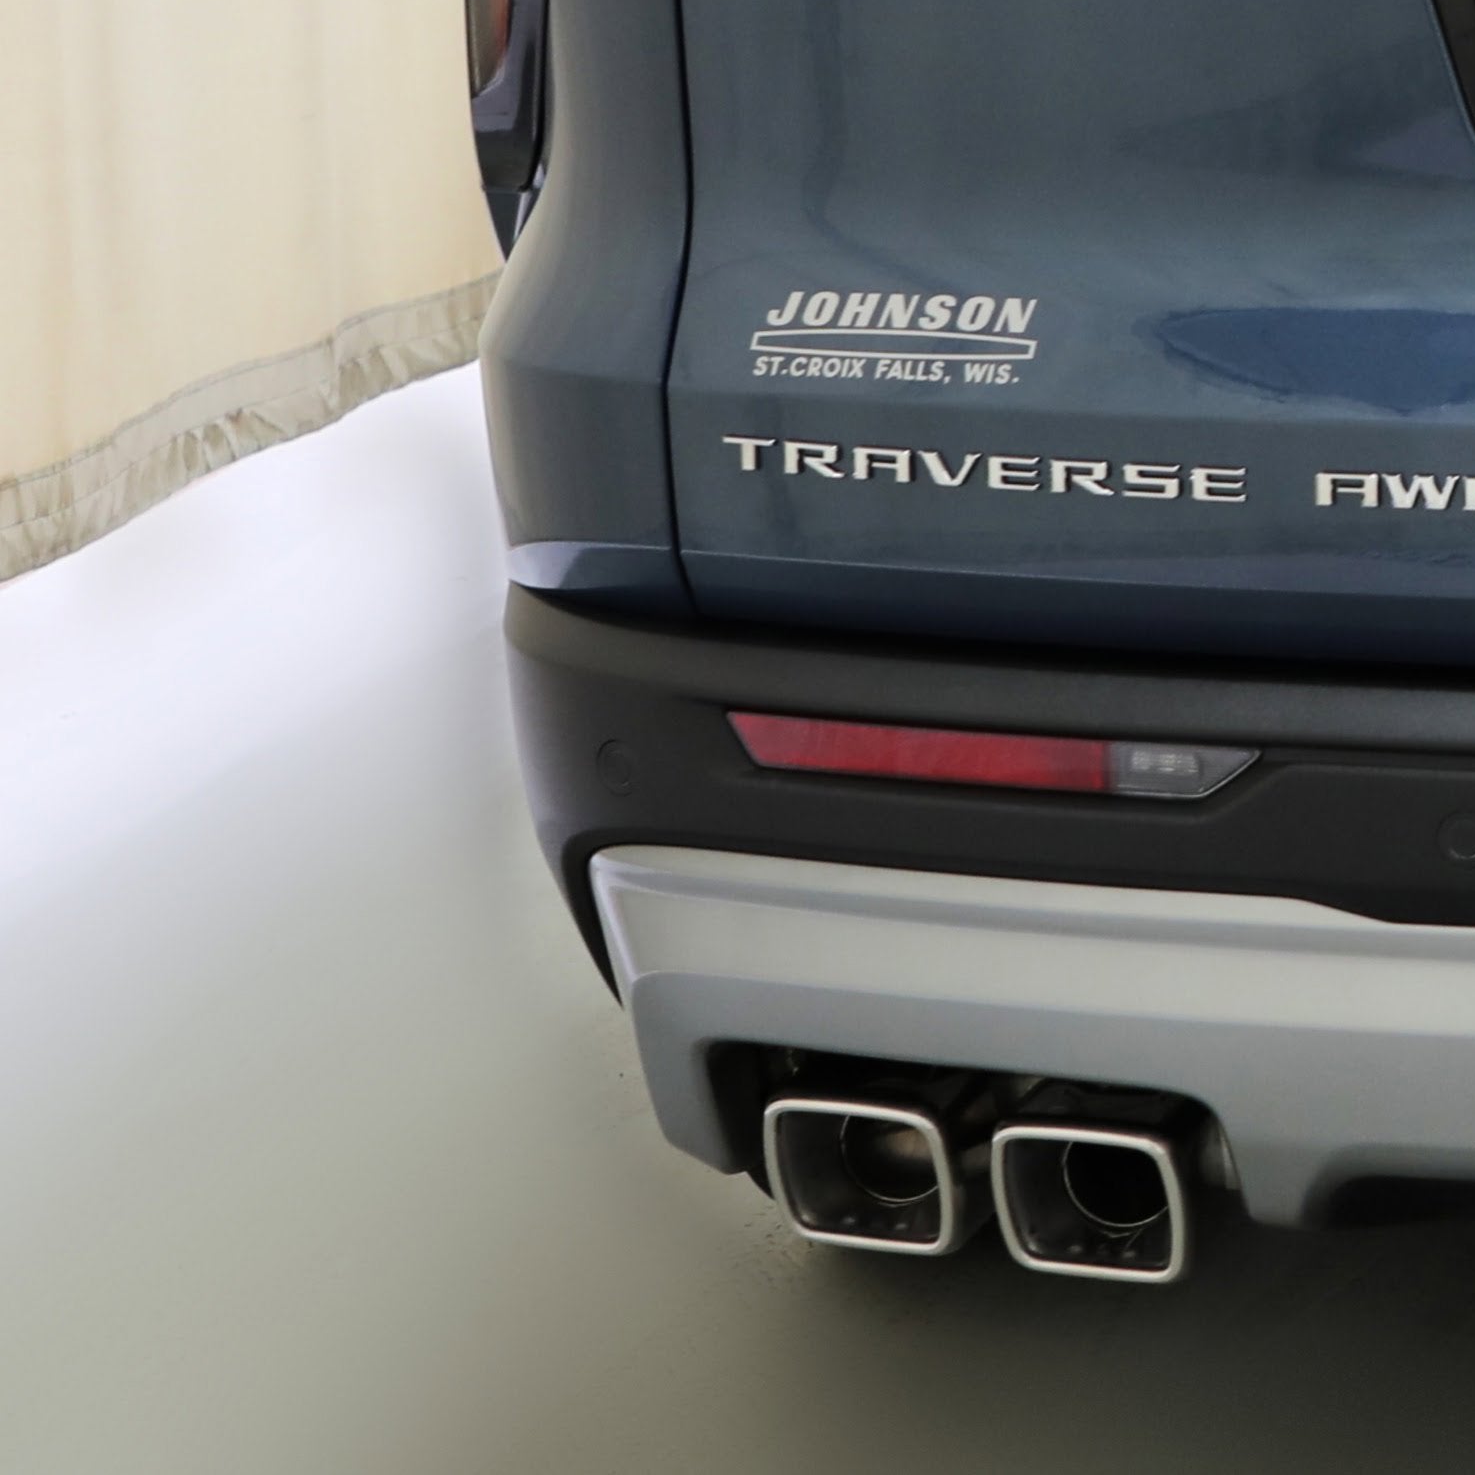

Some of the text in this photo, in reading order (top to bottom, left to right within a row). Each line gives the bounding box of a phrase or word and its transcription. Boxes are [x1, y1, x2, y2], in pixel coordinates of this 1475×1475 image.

[766, 291, 1038, 333] JOHNSON
[874, 359, 952, 384] FALLS,
[963, 362, 1021, 385] WIS.
[721, 434, 1248, 503] TRAVERSE
